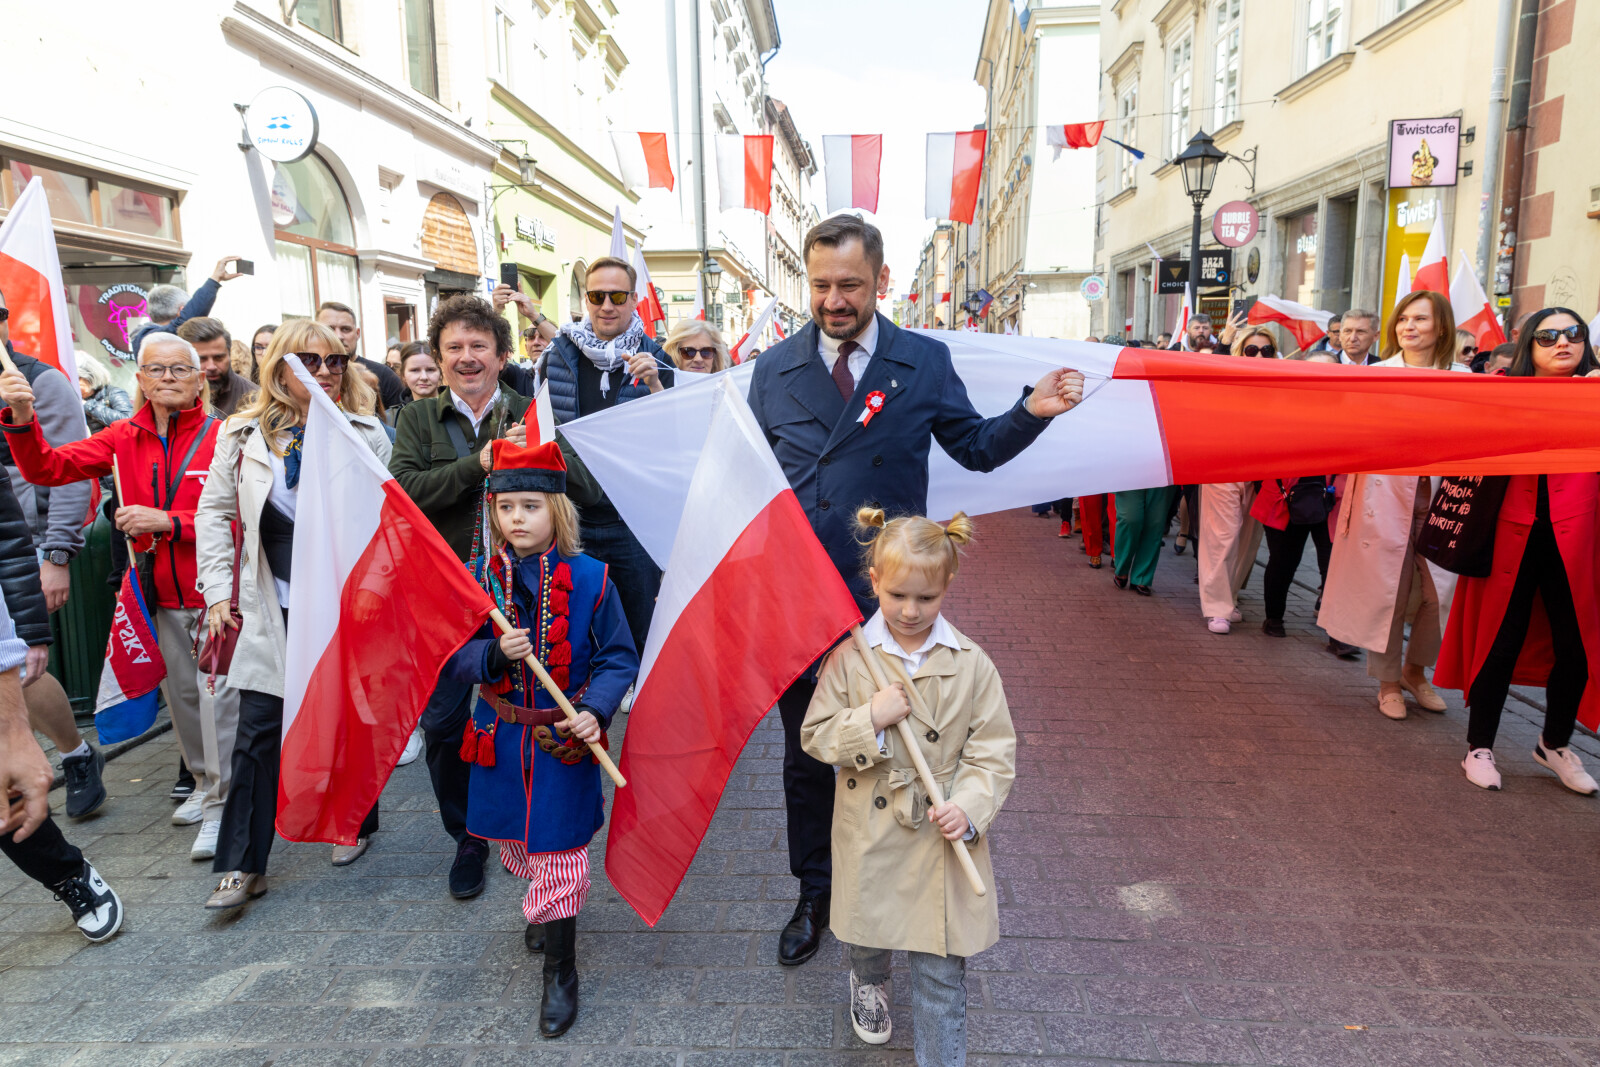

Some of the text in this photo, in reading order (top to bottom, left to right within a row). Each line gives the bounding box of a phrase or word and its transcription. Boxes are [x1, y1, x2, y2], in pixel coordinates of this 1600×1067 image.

[1396, 123, 1456, 136] Twistcafe
[281, 138, 303, 146] ROLLS
[1221, 211, 1251, 225] BUBBLE
[1221, 225, 1236, 238] TEA
[1201, 257, 1224, 268] BAZA
[1201, 268, 1217, 279] PUB
[98, 284, 149, 305] TRADITIONA
[101, 338, 131, 360] POLISH
